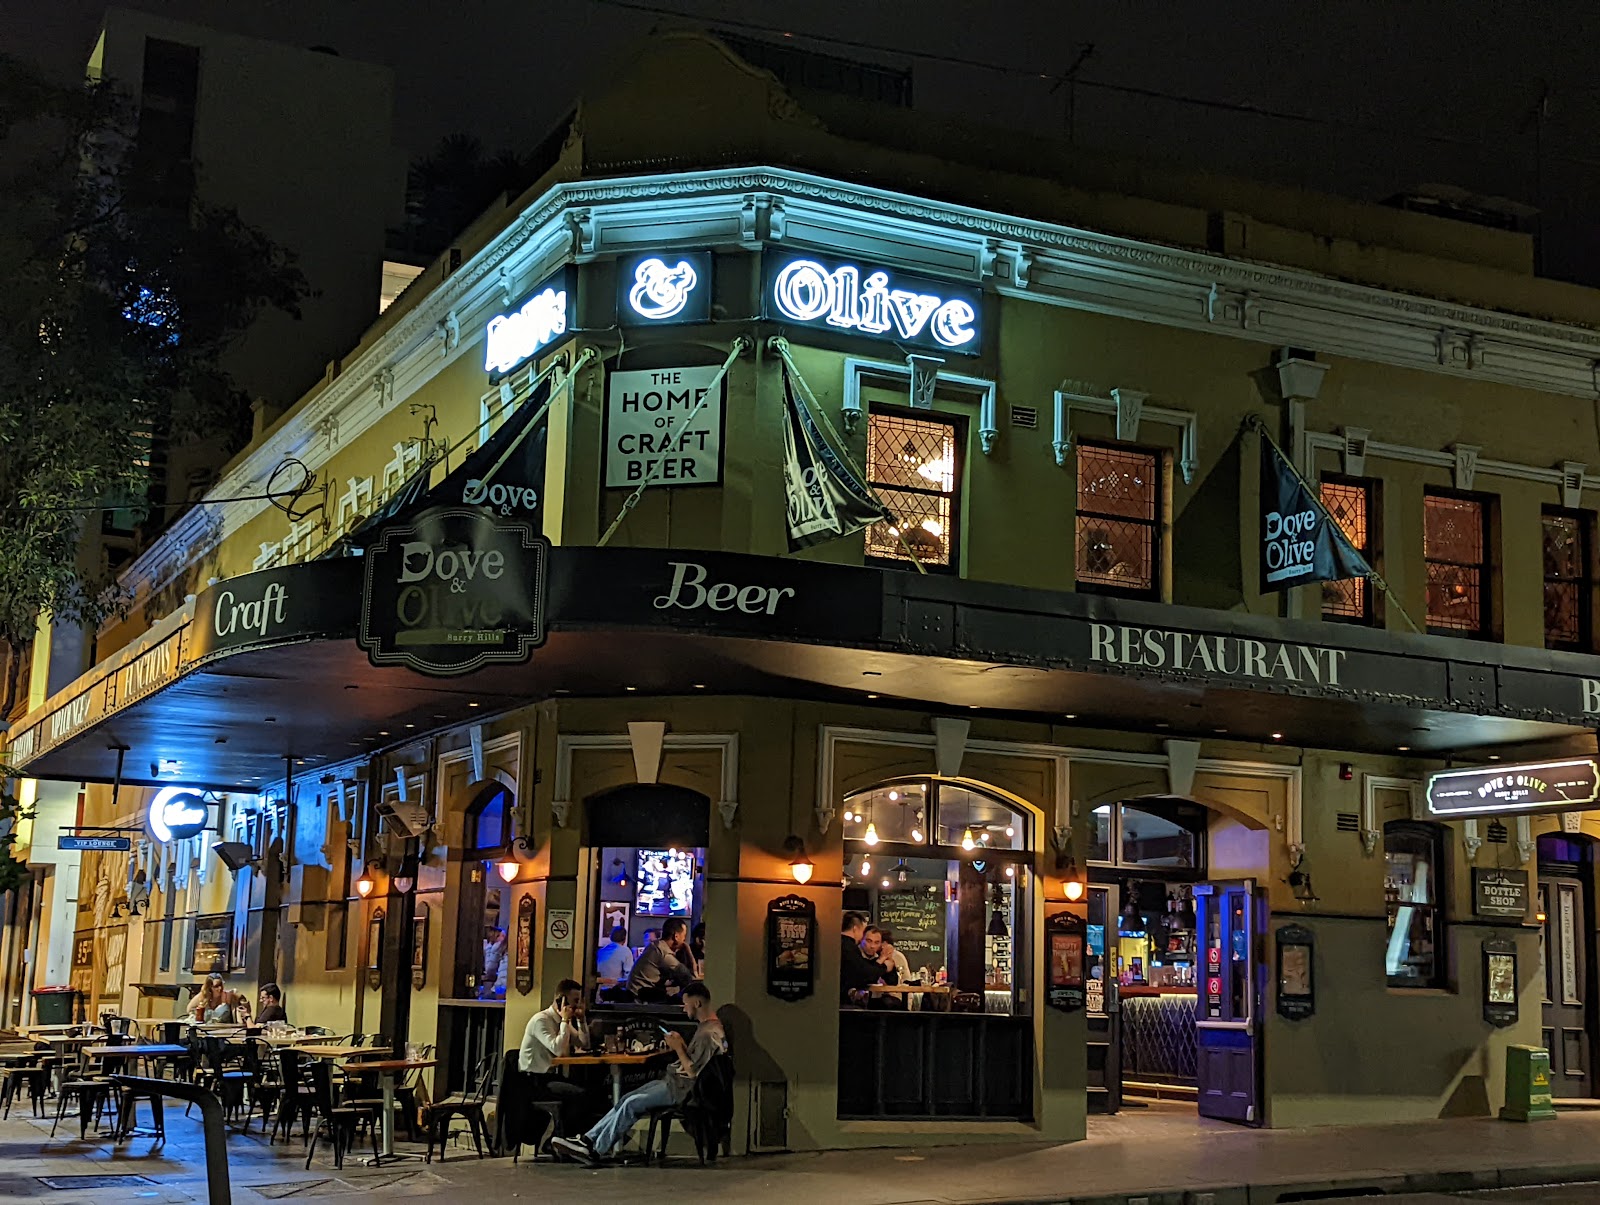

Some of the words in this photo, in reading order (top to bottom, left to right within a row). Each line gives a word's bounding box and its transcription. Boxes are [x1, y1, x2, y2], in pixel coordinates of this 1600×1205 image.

[629, 258, 697, 319] &
[774, 259, 975, 346] Olive
[651, 372, 681, 385] THE
[622, 388, 710, 413] HOME
[654, 416, 675, 428] OF
[617, 430, 710, 455] CRAFT
[627, 458, 697, 480] BEER
[463, 479, 537, 509] Dove
[501, 503, 513, 516] &
[1264, 510, 1316, 542] Dove
[397, 541, 505, 584] Dove
[1266, 540, 1315, 569] Olive
[450, 577, 467, 593] &
[653, 562, 795, 615] Beer
[215, 583, 289, 637] Craft
[477, 632, 500, 641] Hills
[1088, 623, 1346, 685] RESTAURANT
[1478, 777, 1504, 798] DOVE
[1516, 775, 1548, 794] OLIVE
[1484, 887, 1521, 897] BOTTLE
[1490, 896, 1516, 906] SHOP
